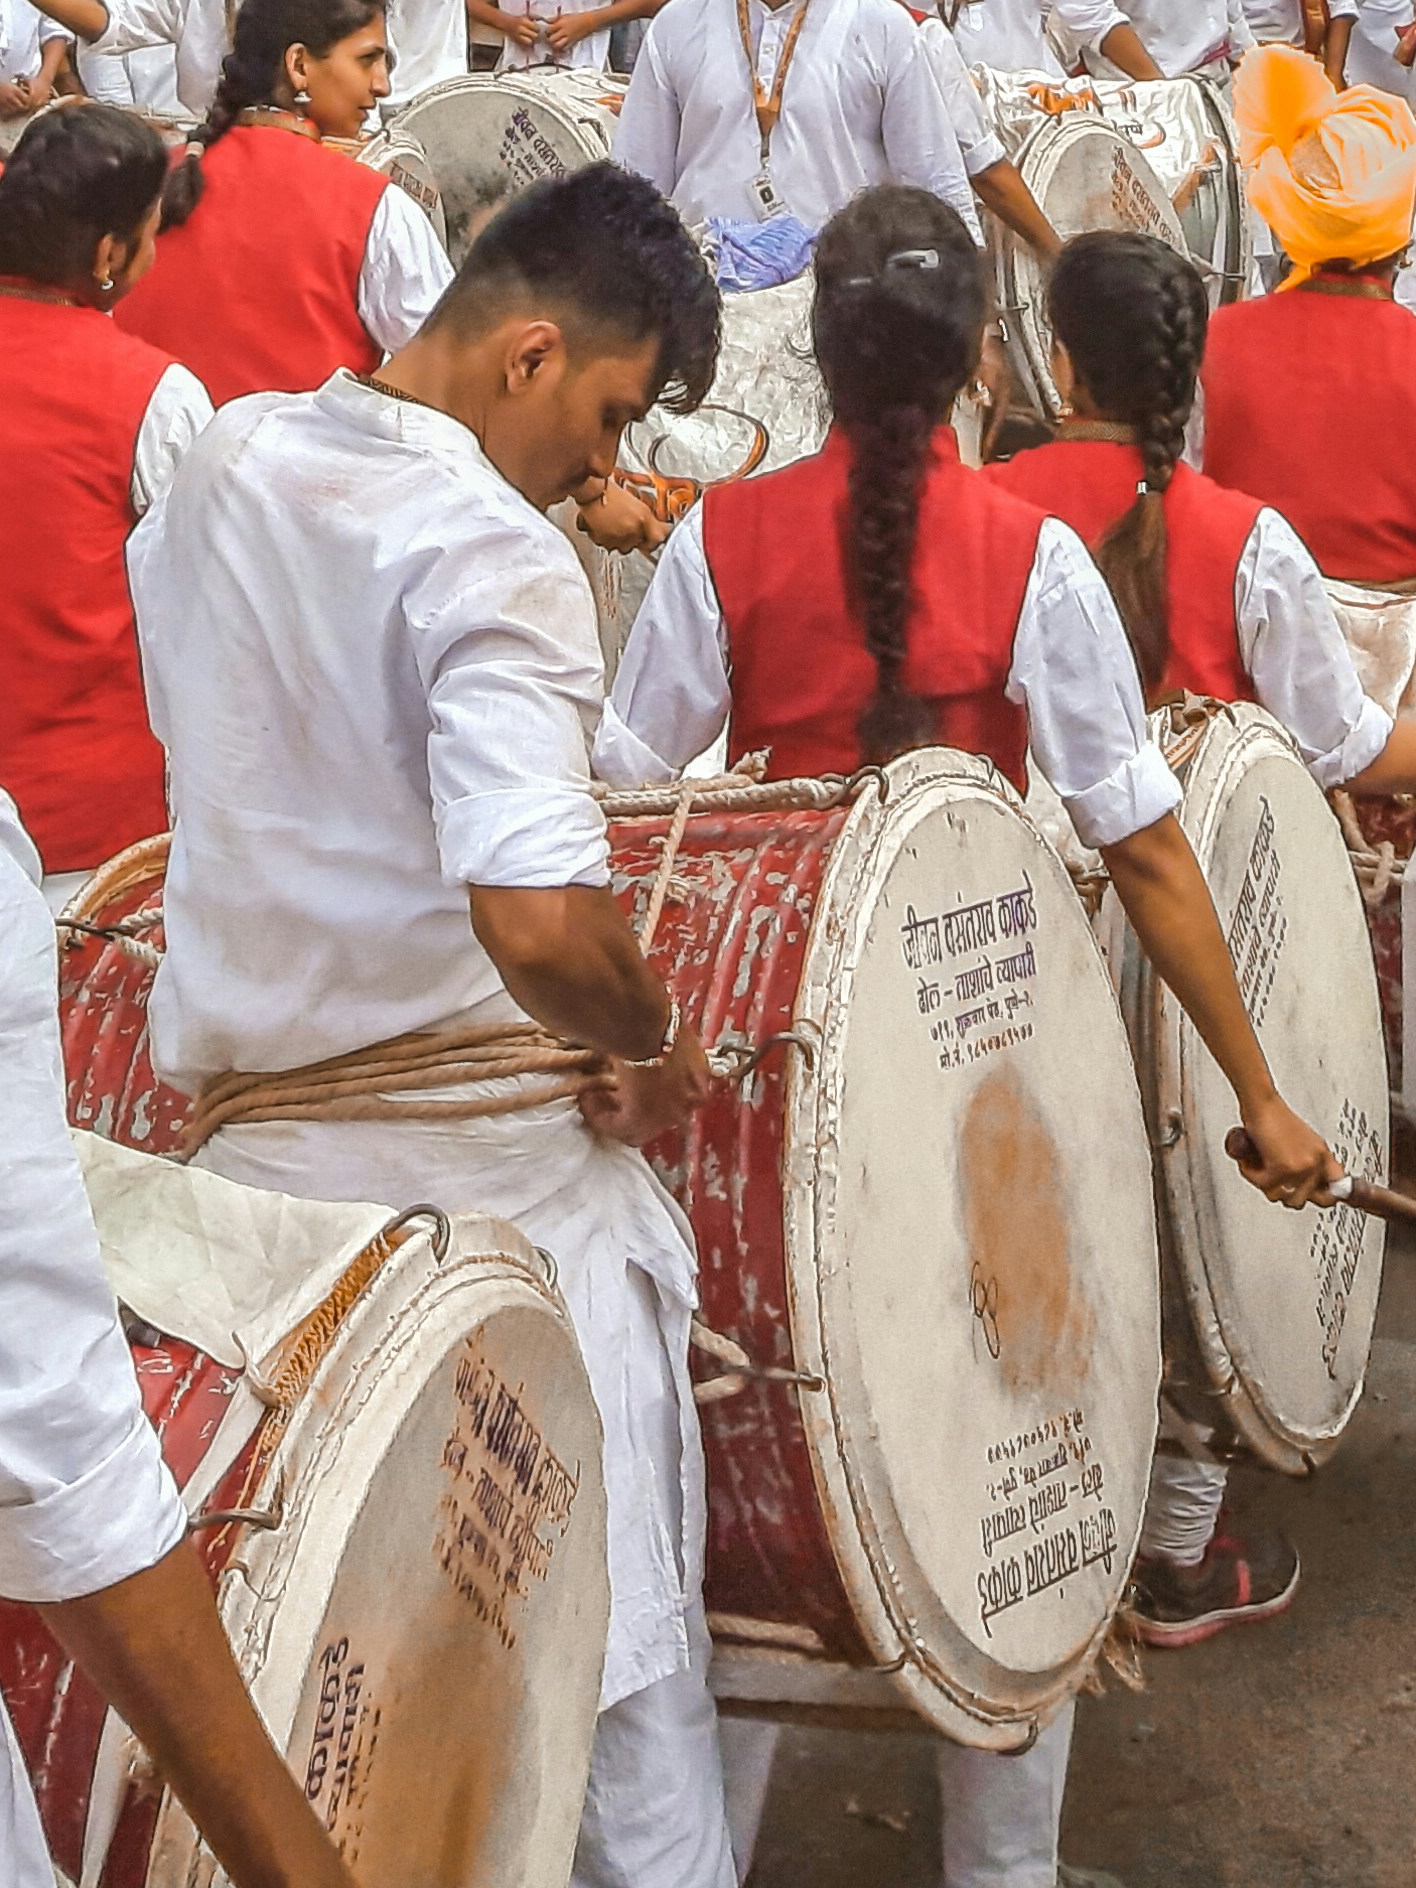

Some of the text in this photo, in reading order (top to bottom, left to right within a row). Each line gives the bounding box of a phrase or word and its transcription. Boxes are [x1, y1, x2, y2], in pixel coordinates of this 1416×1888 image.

[901, 868, 1037, 970] जीवन वसंतराव काकडे
[917, 977, 941, 1015] ढोल
[954, 953, 994, 1002] ताशांचे
[977, 1555, 1024, 1639] काकडे
[1025, 1527, 1080, 1600] वसंतराव
